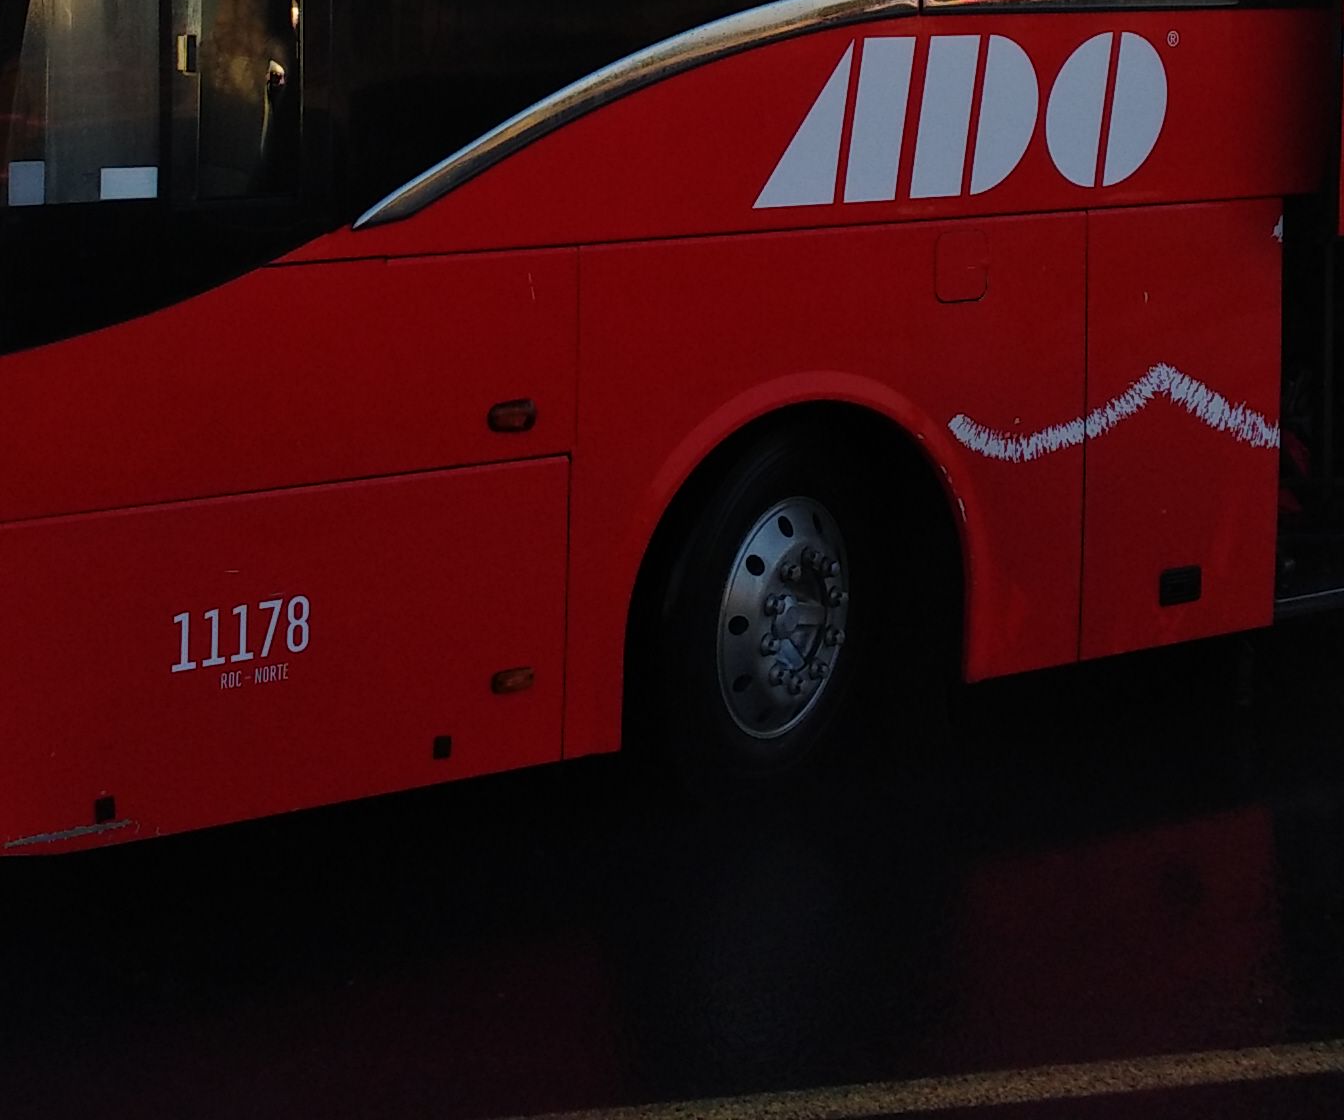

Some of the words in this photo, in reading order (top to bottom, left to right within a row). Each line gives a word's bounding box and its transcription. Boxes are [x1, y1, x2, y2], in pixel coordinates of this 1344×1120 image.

[752, 32, 1168, 208] ADO
[171, 595, 310, 673] 11178
[220, 670, 242, 690] ROC
[254, 662, 289, 685] NORTE
